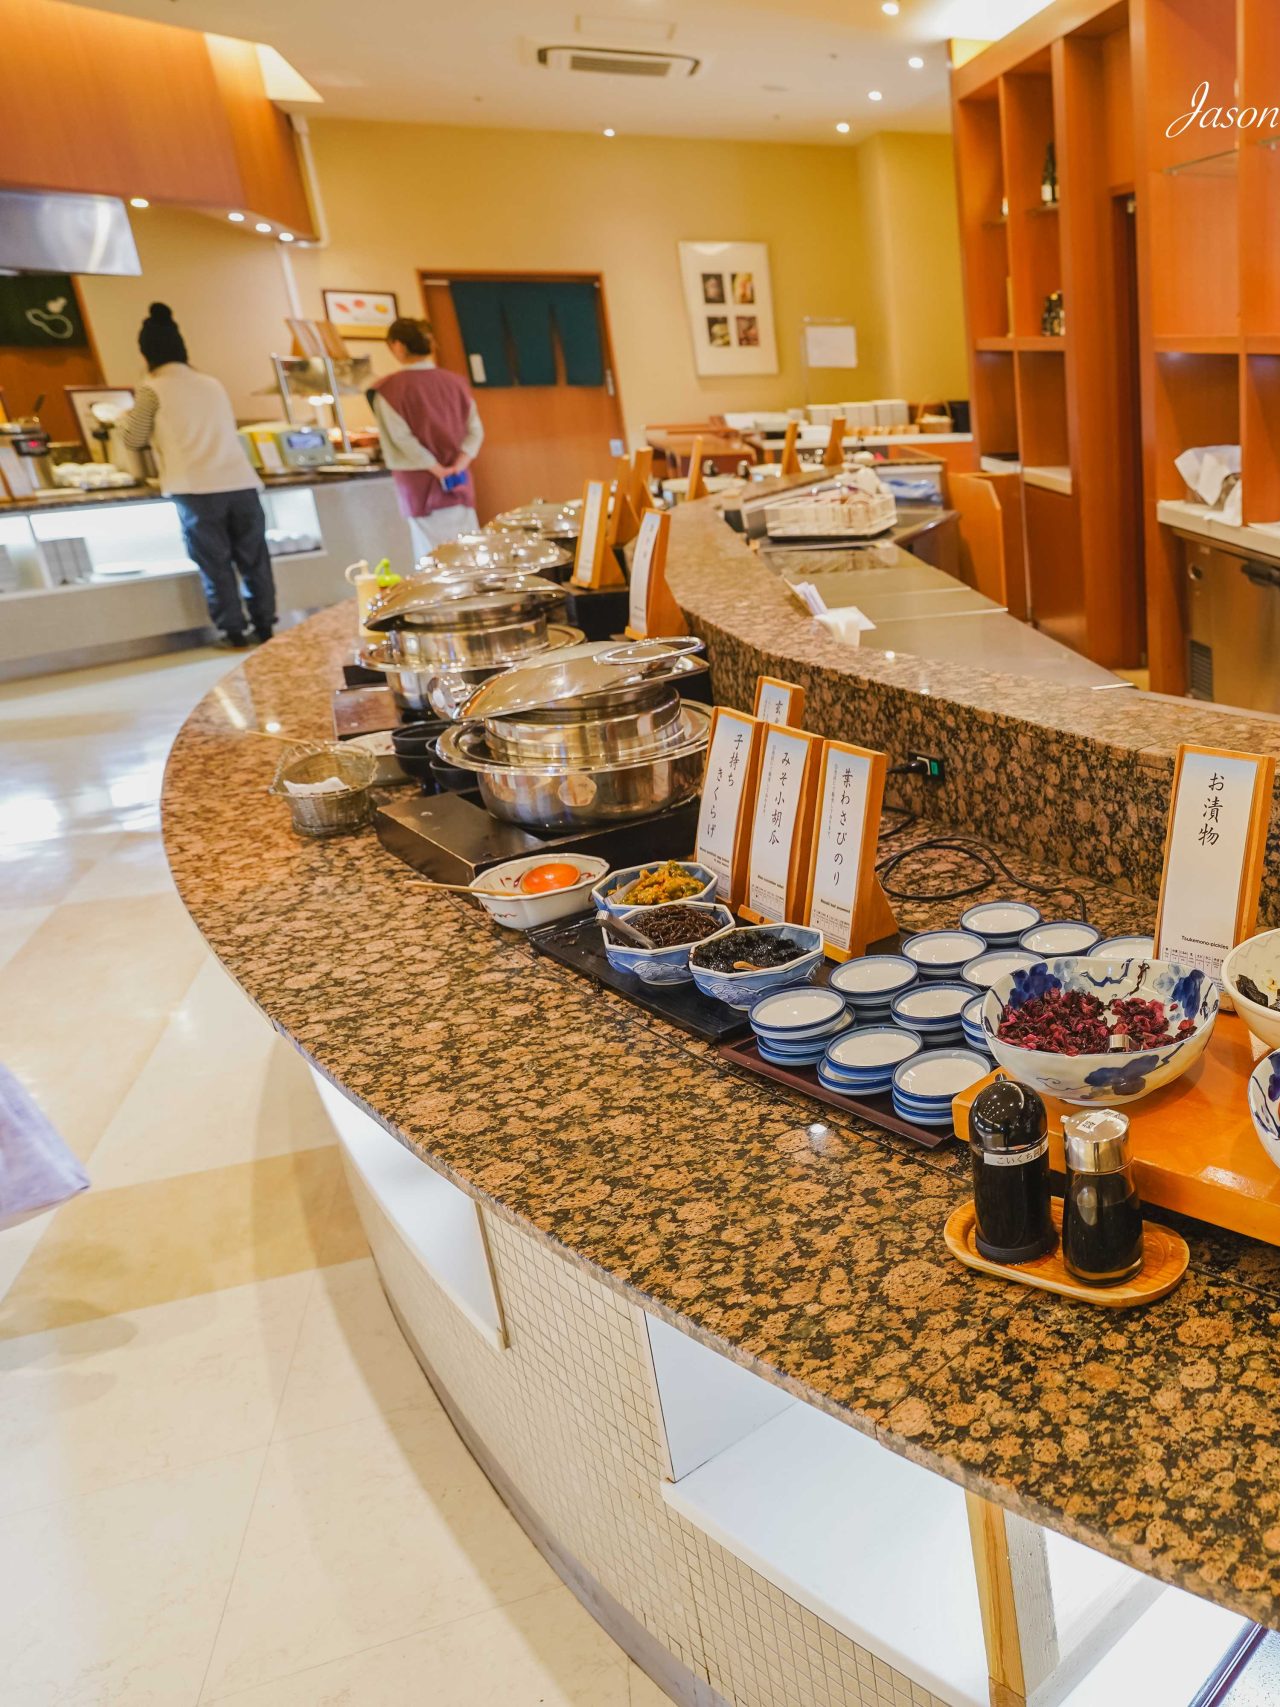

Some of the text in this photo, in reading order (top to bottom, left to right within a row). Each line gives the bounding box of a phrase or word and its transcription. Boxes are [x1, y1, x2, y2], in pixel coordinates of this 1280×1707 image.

[728, 733, 744, 787] 子持ち
[707, 767, 723, 838] きくらげ
[768, 752, 791, 845] みそ小胡瓜
[833, 767, 854, 886] 葉わさびのり
[1198, 772, 1225, 846] お漬物
